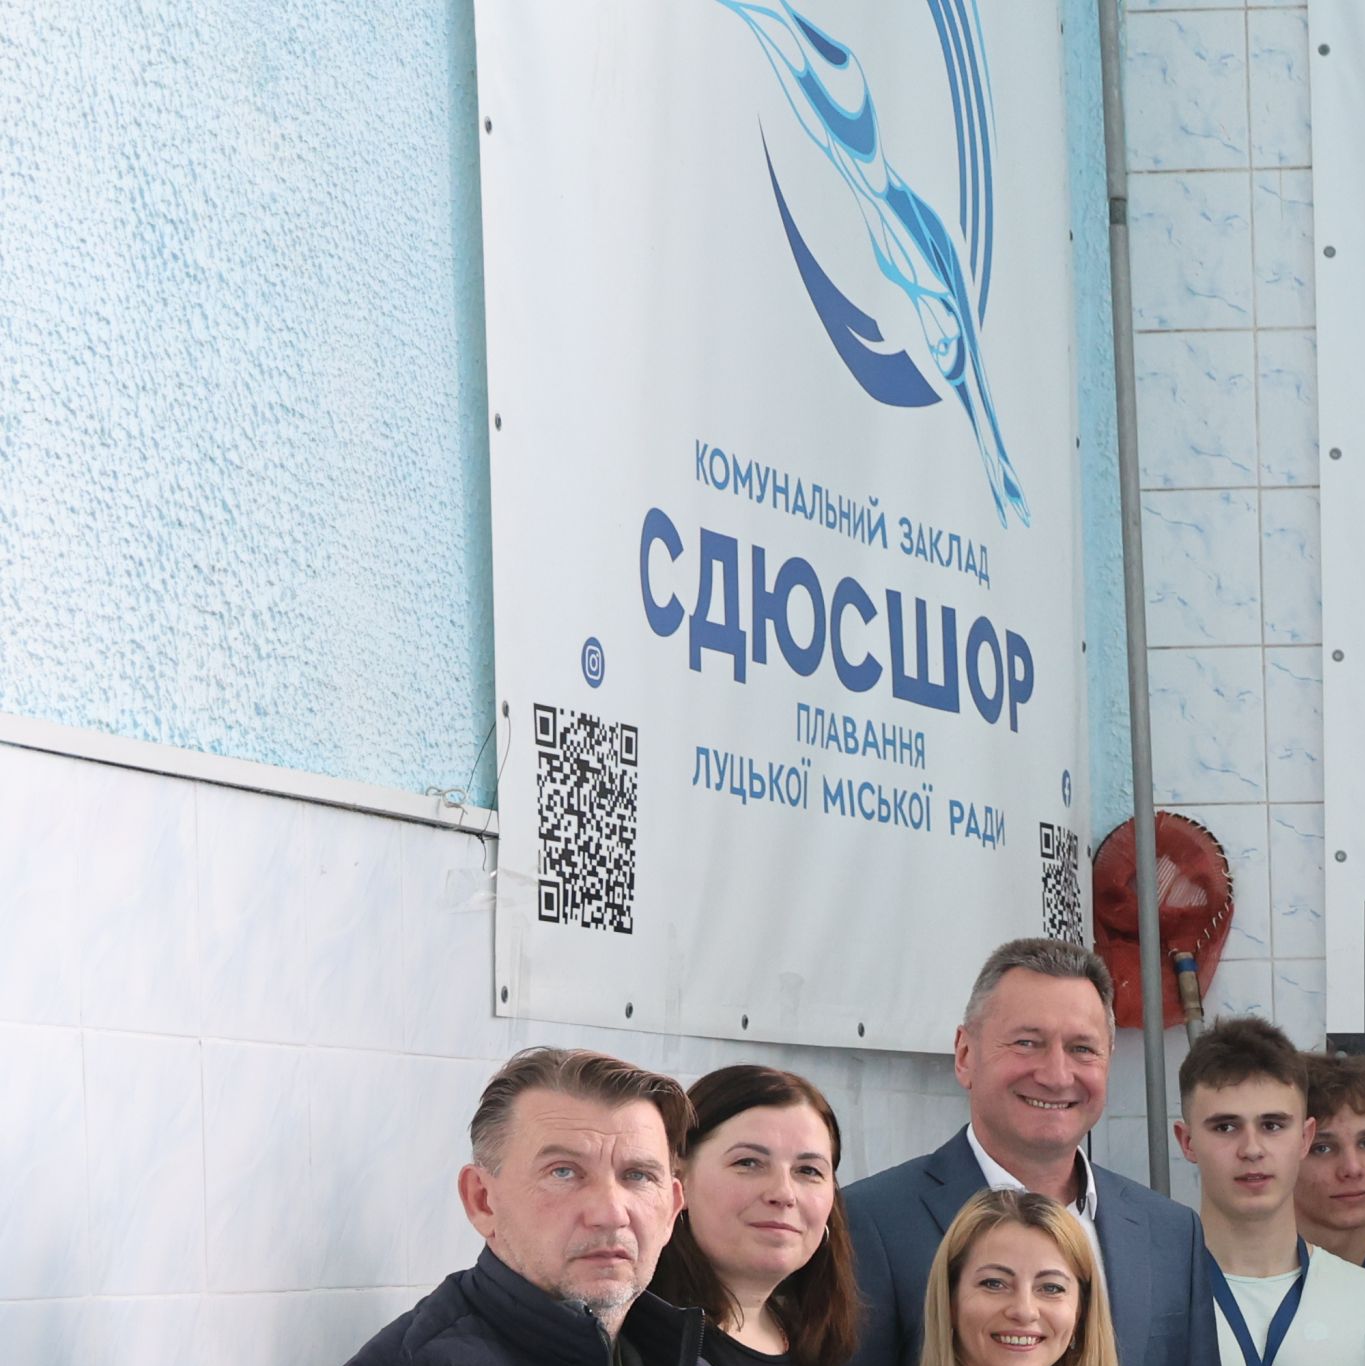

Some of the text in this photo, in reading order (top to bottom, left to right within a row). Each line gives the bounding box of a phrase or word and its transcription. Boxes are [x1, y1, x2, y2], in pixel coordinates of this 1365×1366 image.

[695, 440, 991, 590] КОМУНАЛЬНИЙ ЗАКЛАД
[640, 507, 1035, 733] СДЮСШОР
[692, 745, 1006, 847] ЛУЦЬКОЇ МІСЬКОЇ РАДИ
[796, 702, 926, 769] ПЛАВАННЯ
